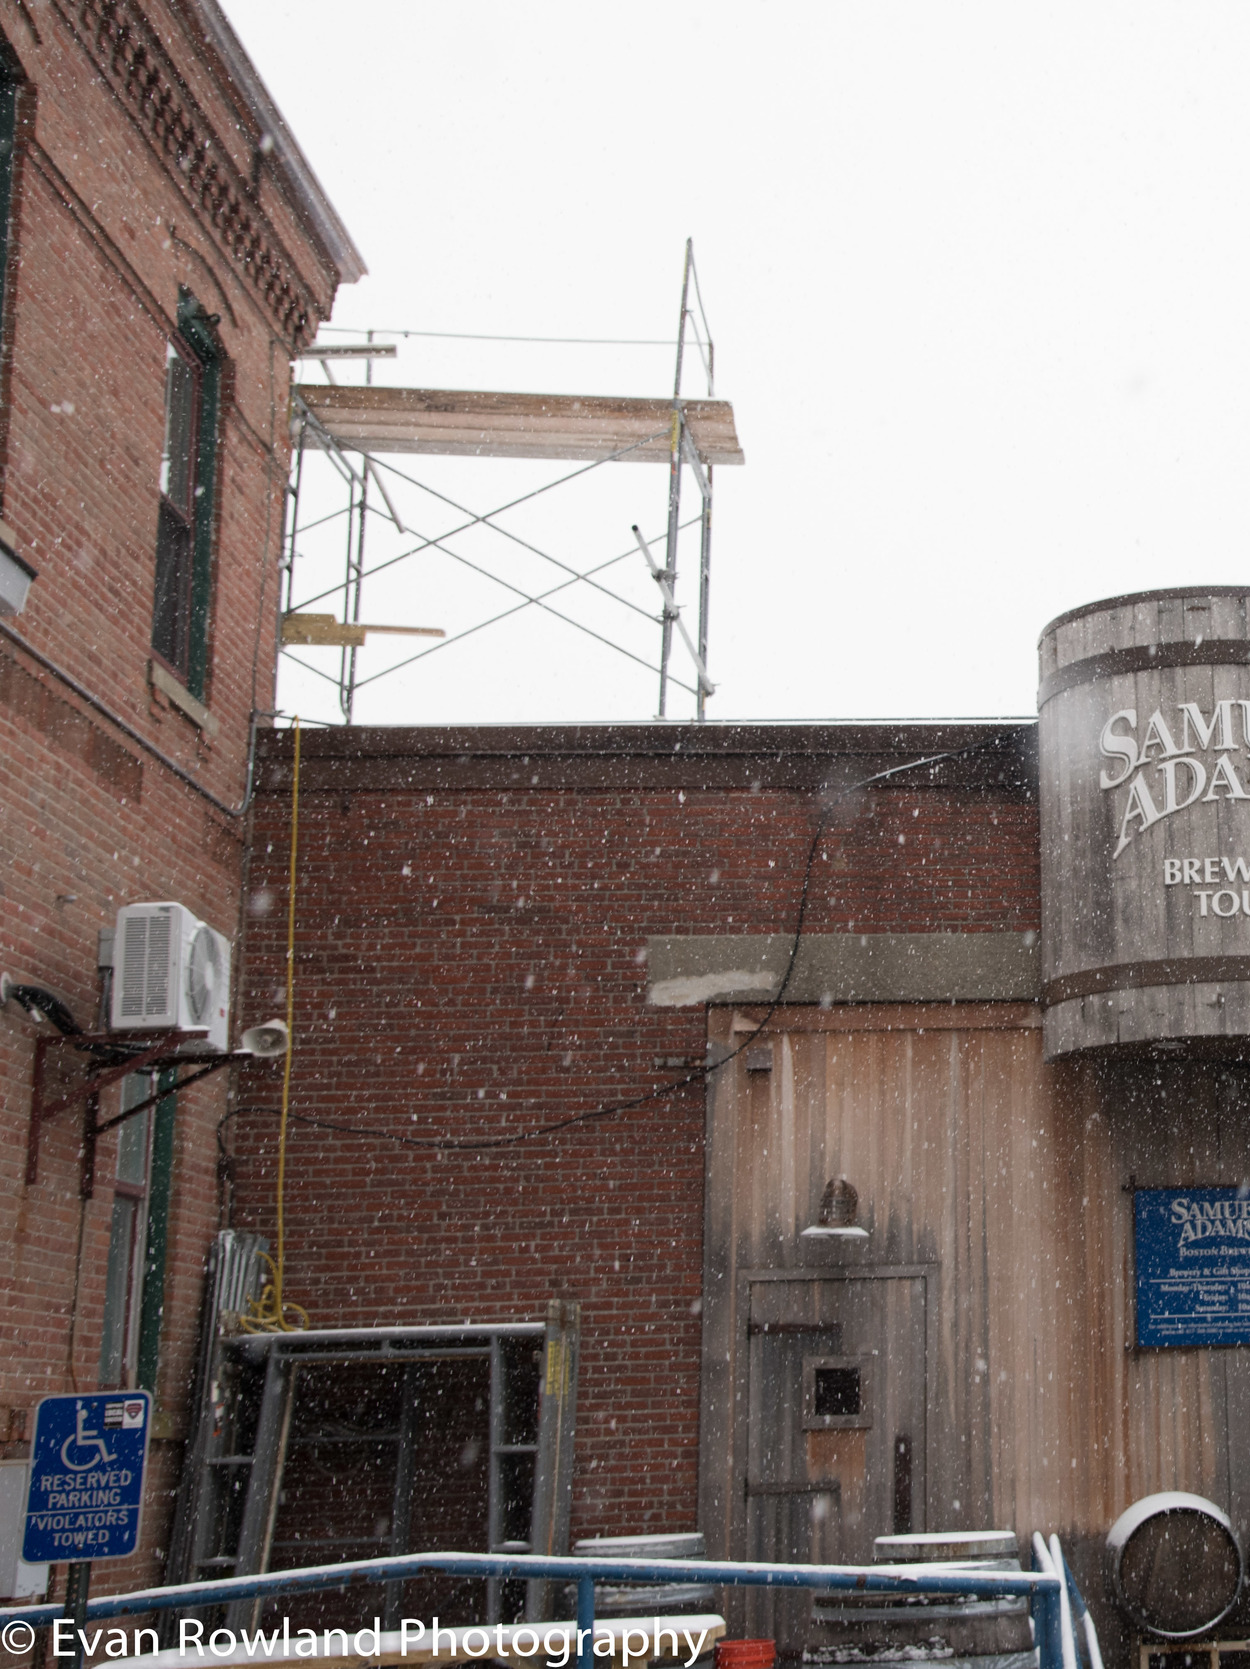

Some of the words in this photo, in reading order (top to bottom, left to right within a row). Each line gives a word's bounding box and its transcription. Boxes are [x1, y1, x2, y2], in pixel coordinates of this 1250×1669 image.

[1169, 1268, 1201, 1277] Brewery
[1213, 1266, 1229, 1275] Gift
[1230, 1266, 1250, 1275] Shop
[40, 1470, 133, 1492] RESERVED
[48, 1488, 121, 1509] PARKING
[37, 1511, 129, 1531] VIOLATORS
[53, 1530, 110, 1547] TOWED
